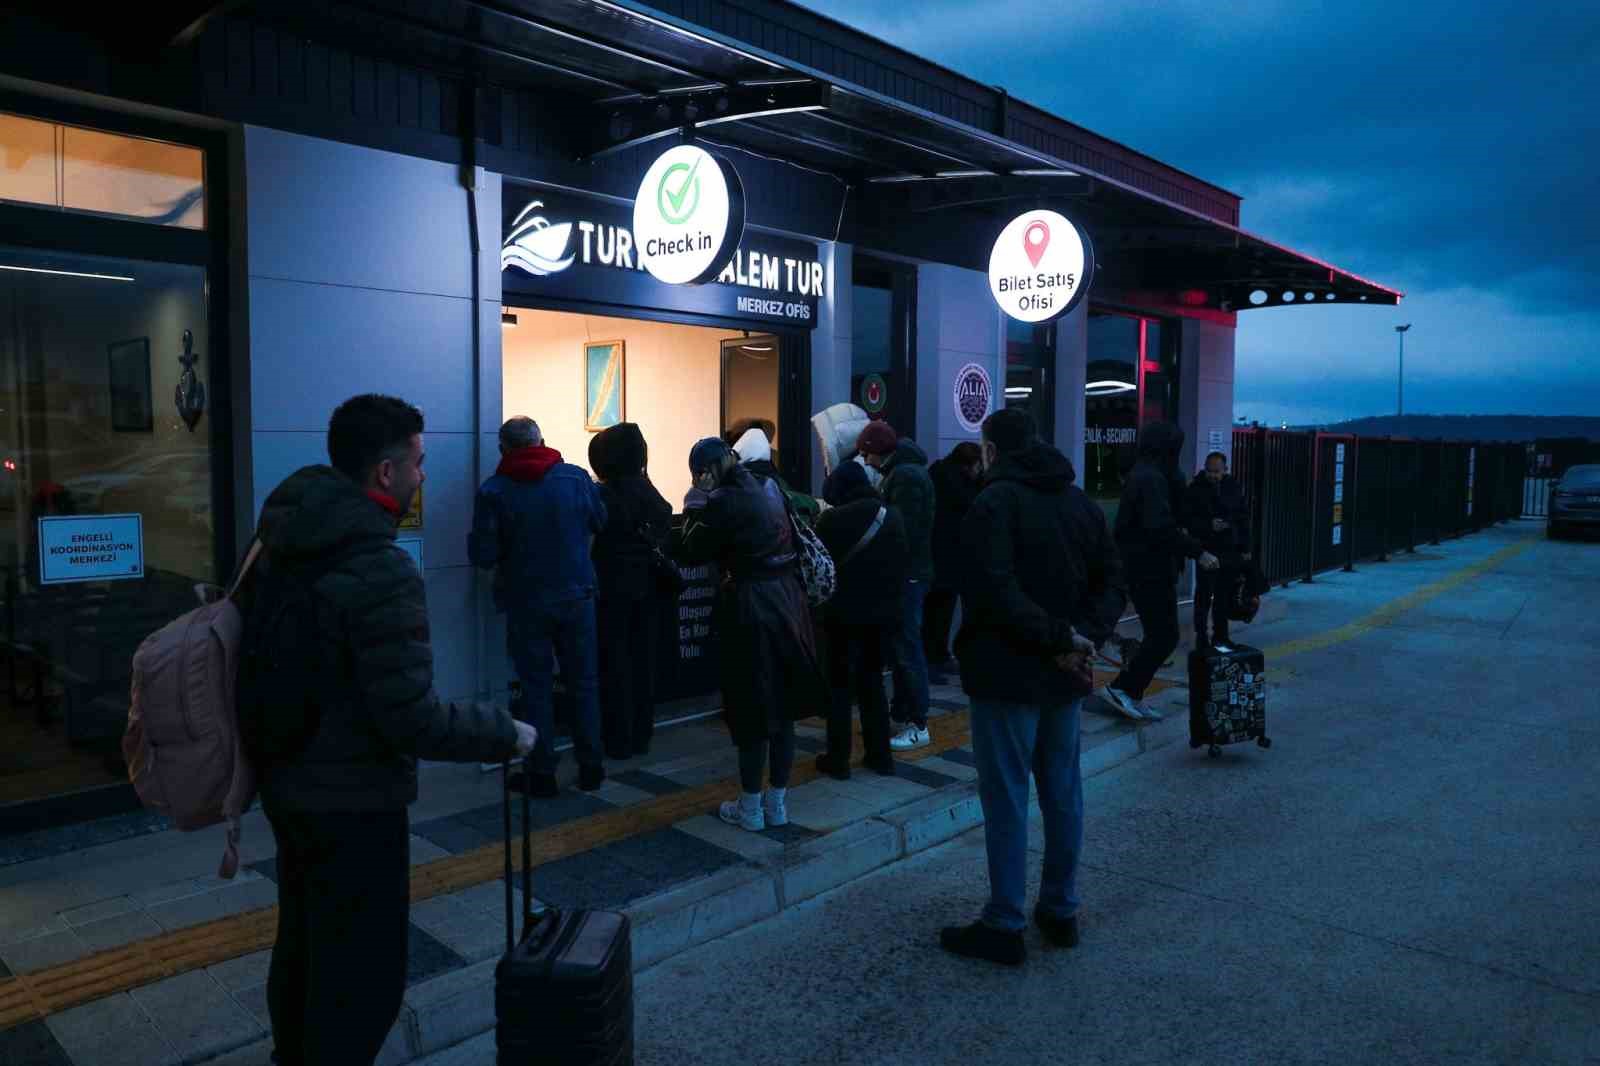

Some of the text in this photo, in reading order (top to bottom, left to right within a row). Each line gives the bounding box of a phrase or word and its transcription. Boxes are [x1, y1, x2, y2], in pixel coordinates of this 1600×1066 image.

[646, 231, 712, 257] Check in
[784, 258, 824, 297] TUR
[999, 272, 1075, 292] Bilet Satış
[737, 296, 811, 319] MERKEZ OFİS
[1018, 293, 1053, 311] Ofisi
[71, 530, 113, 543] ENGELLİ
[50, 542, 134, 555] KOORDİNASYON
[69, 552, 117, 565] MERKEZİ
